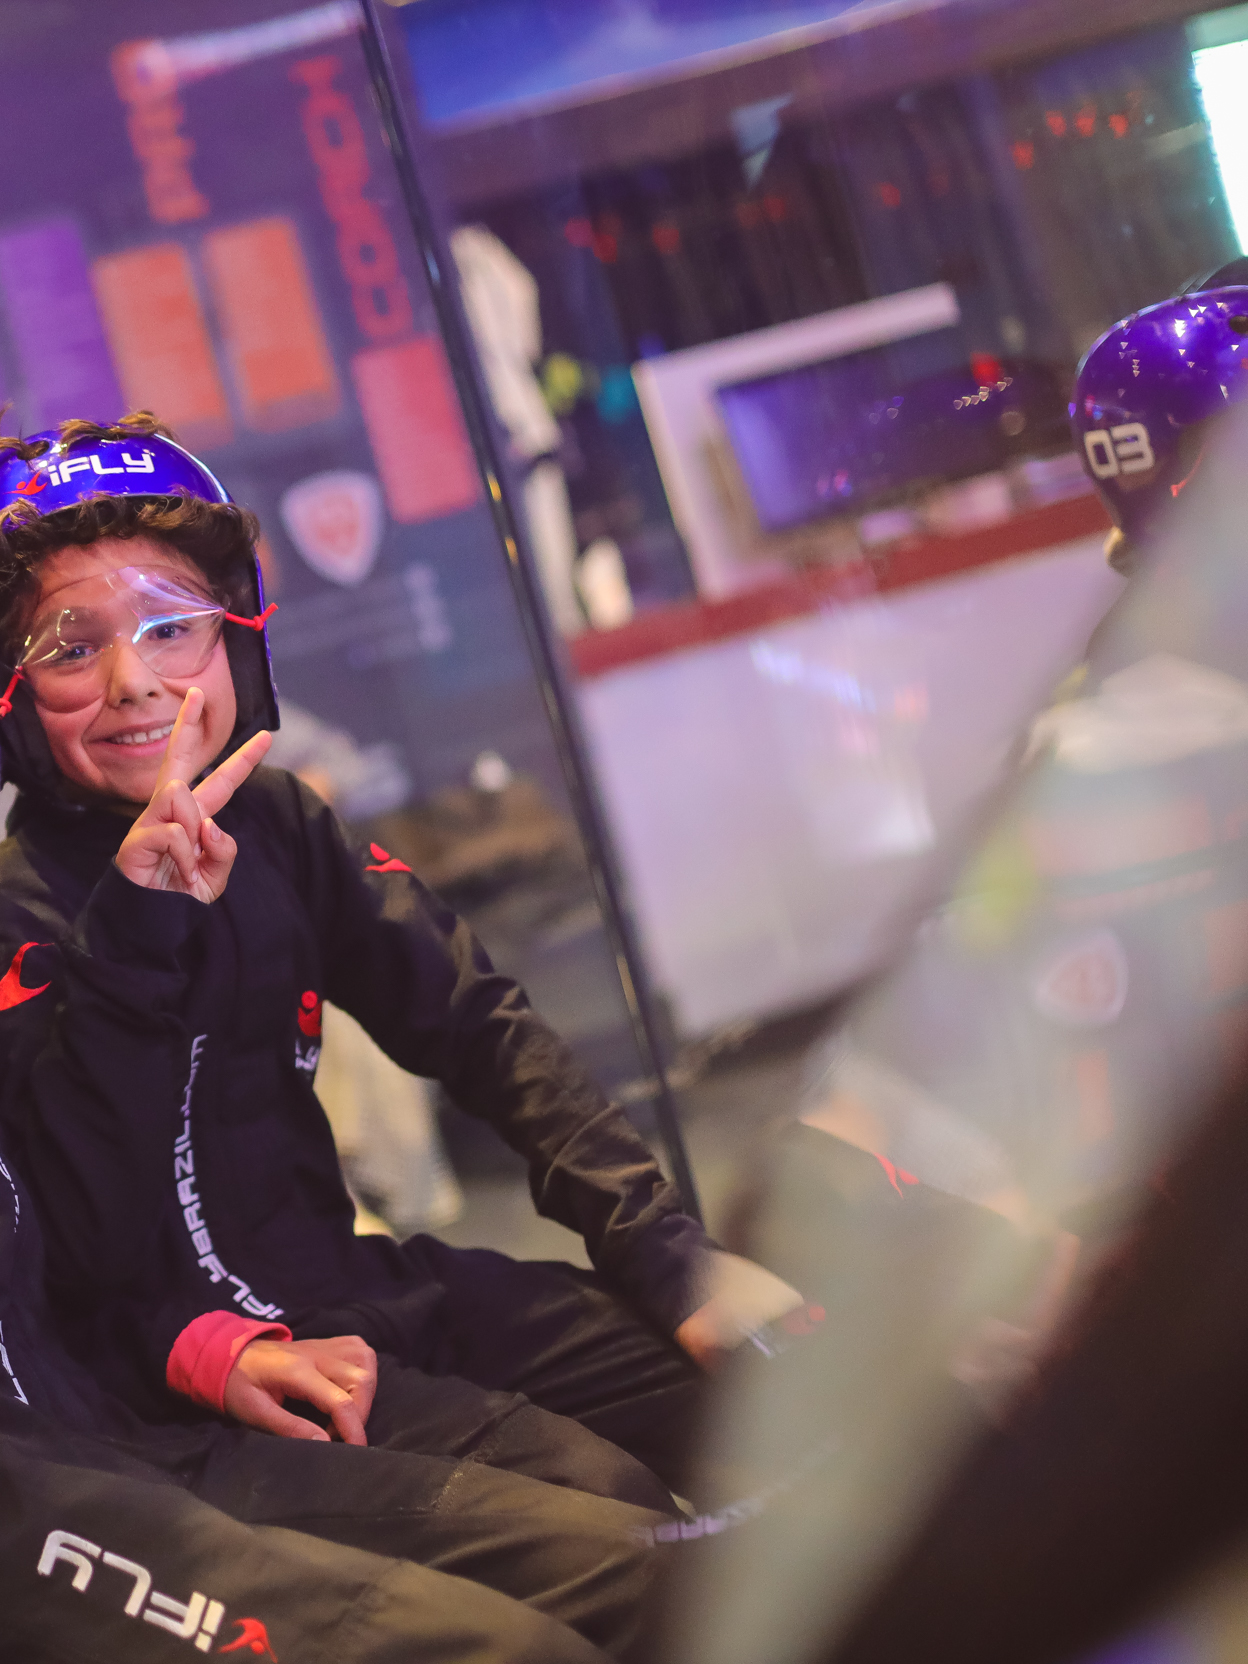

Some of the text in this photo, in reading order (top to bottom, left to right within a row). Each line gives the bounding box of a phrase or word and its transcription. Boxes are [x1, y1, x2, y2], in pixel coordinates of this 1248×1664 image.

[288, 54, 414, 342] COACH
[47, 452, 155, 486] iFLY
[1084, 422, 1155, 479] 03
